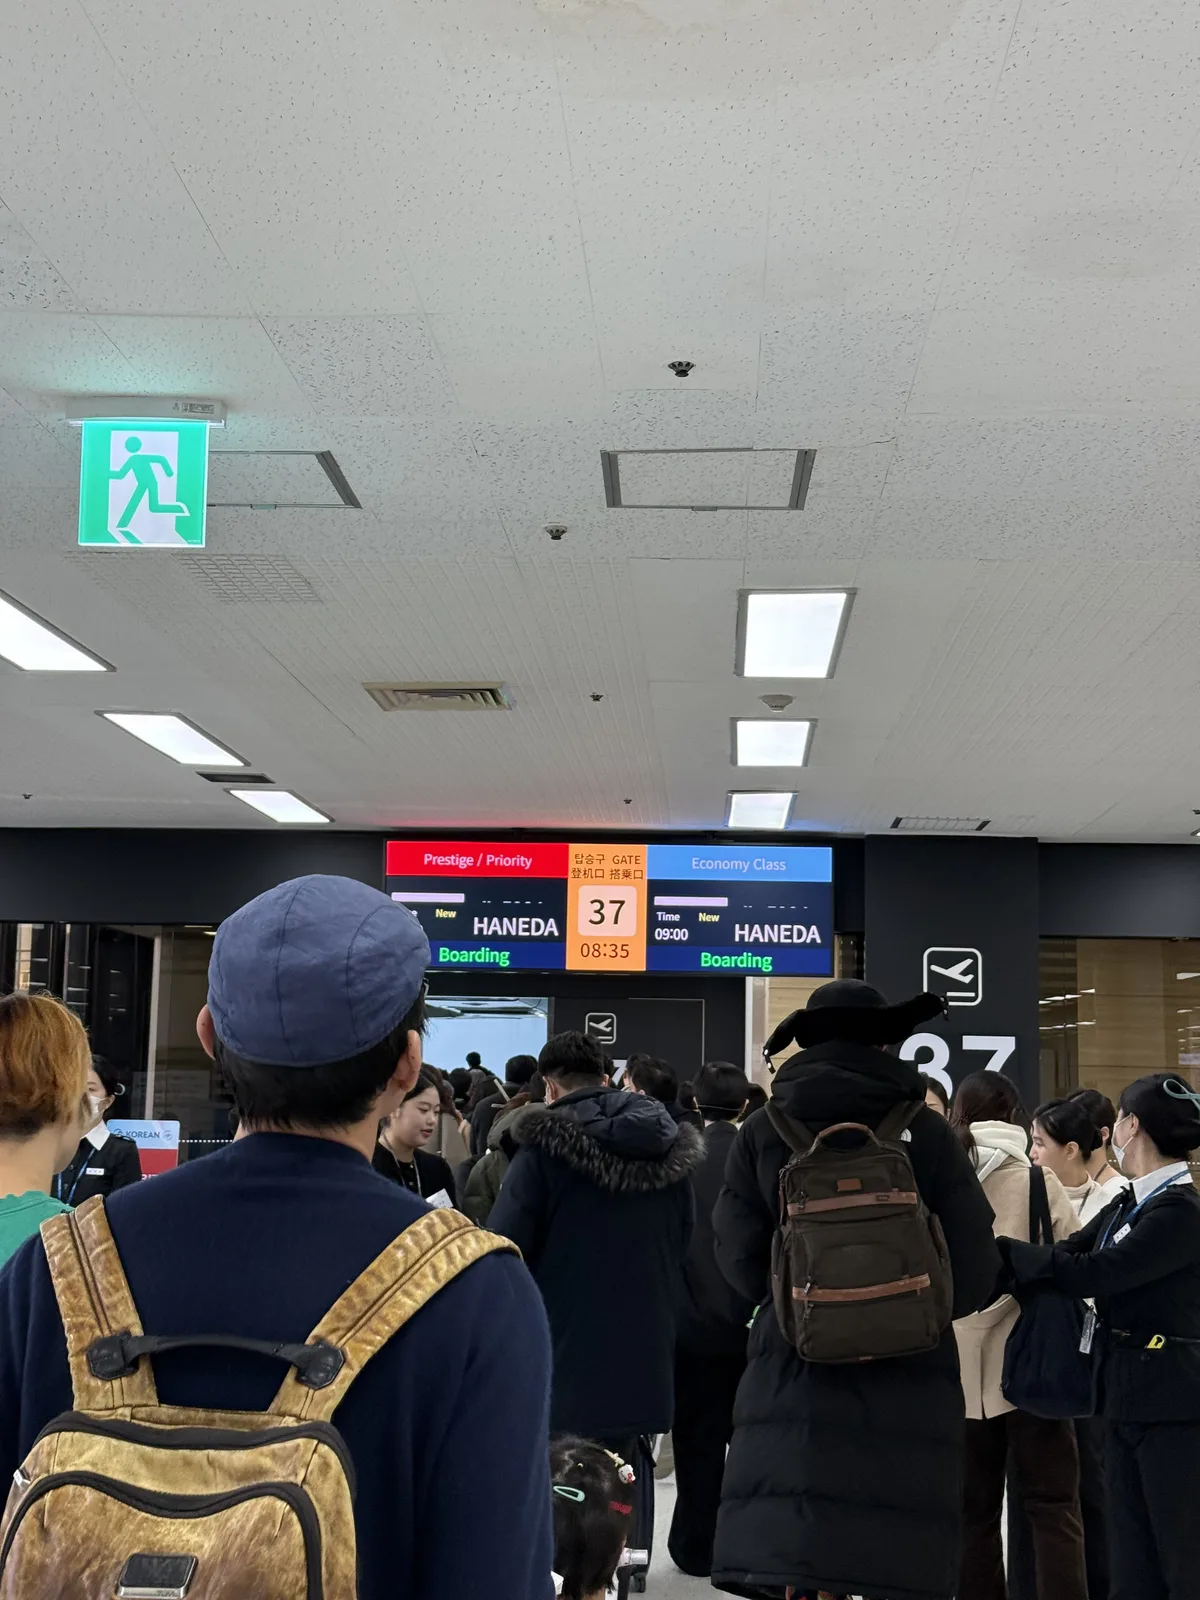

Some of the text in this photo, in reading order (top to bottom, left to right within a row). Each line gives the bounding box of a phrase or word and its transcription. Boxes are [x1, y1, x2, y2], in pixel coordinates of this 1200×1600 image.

[424, 853, 532, 870] Prestige / Priority
[575, 854, 605, 865] 탑승구
[612, 855, 641, 864] GATE
[692, 858, 786, 872] Economy Class
[571, 868, 605, 878] 登机口
[609, 869, 643, 880] 搭乗口
[436, 909, 457, 918] New
[588, 899, 626, 925] 37
[657, 912, 680, 922] Time
[699, 912, 719, 922] New
[473, 917, 559, 936] HANEDA
[655, 928, 688, 940] 09:00
[735, 924, 821, 944] HANEDA
[580, 943, 629, 958] 08:35
[439, 947, 510, 967] Boarding
[701, 952, 772, 971] Boarding
[126, 1130, 160, 1139] KOREAN
